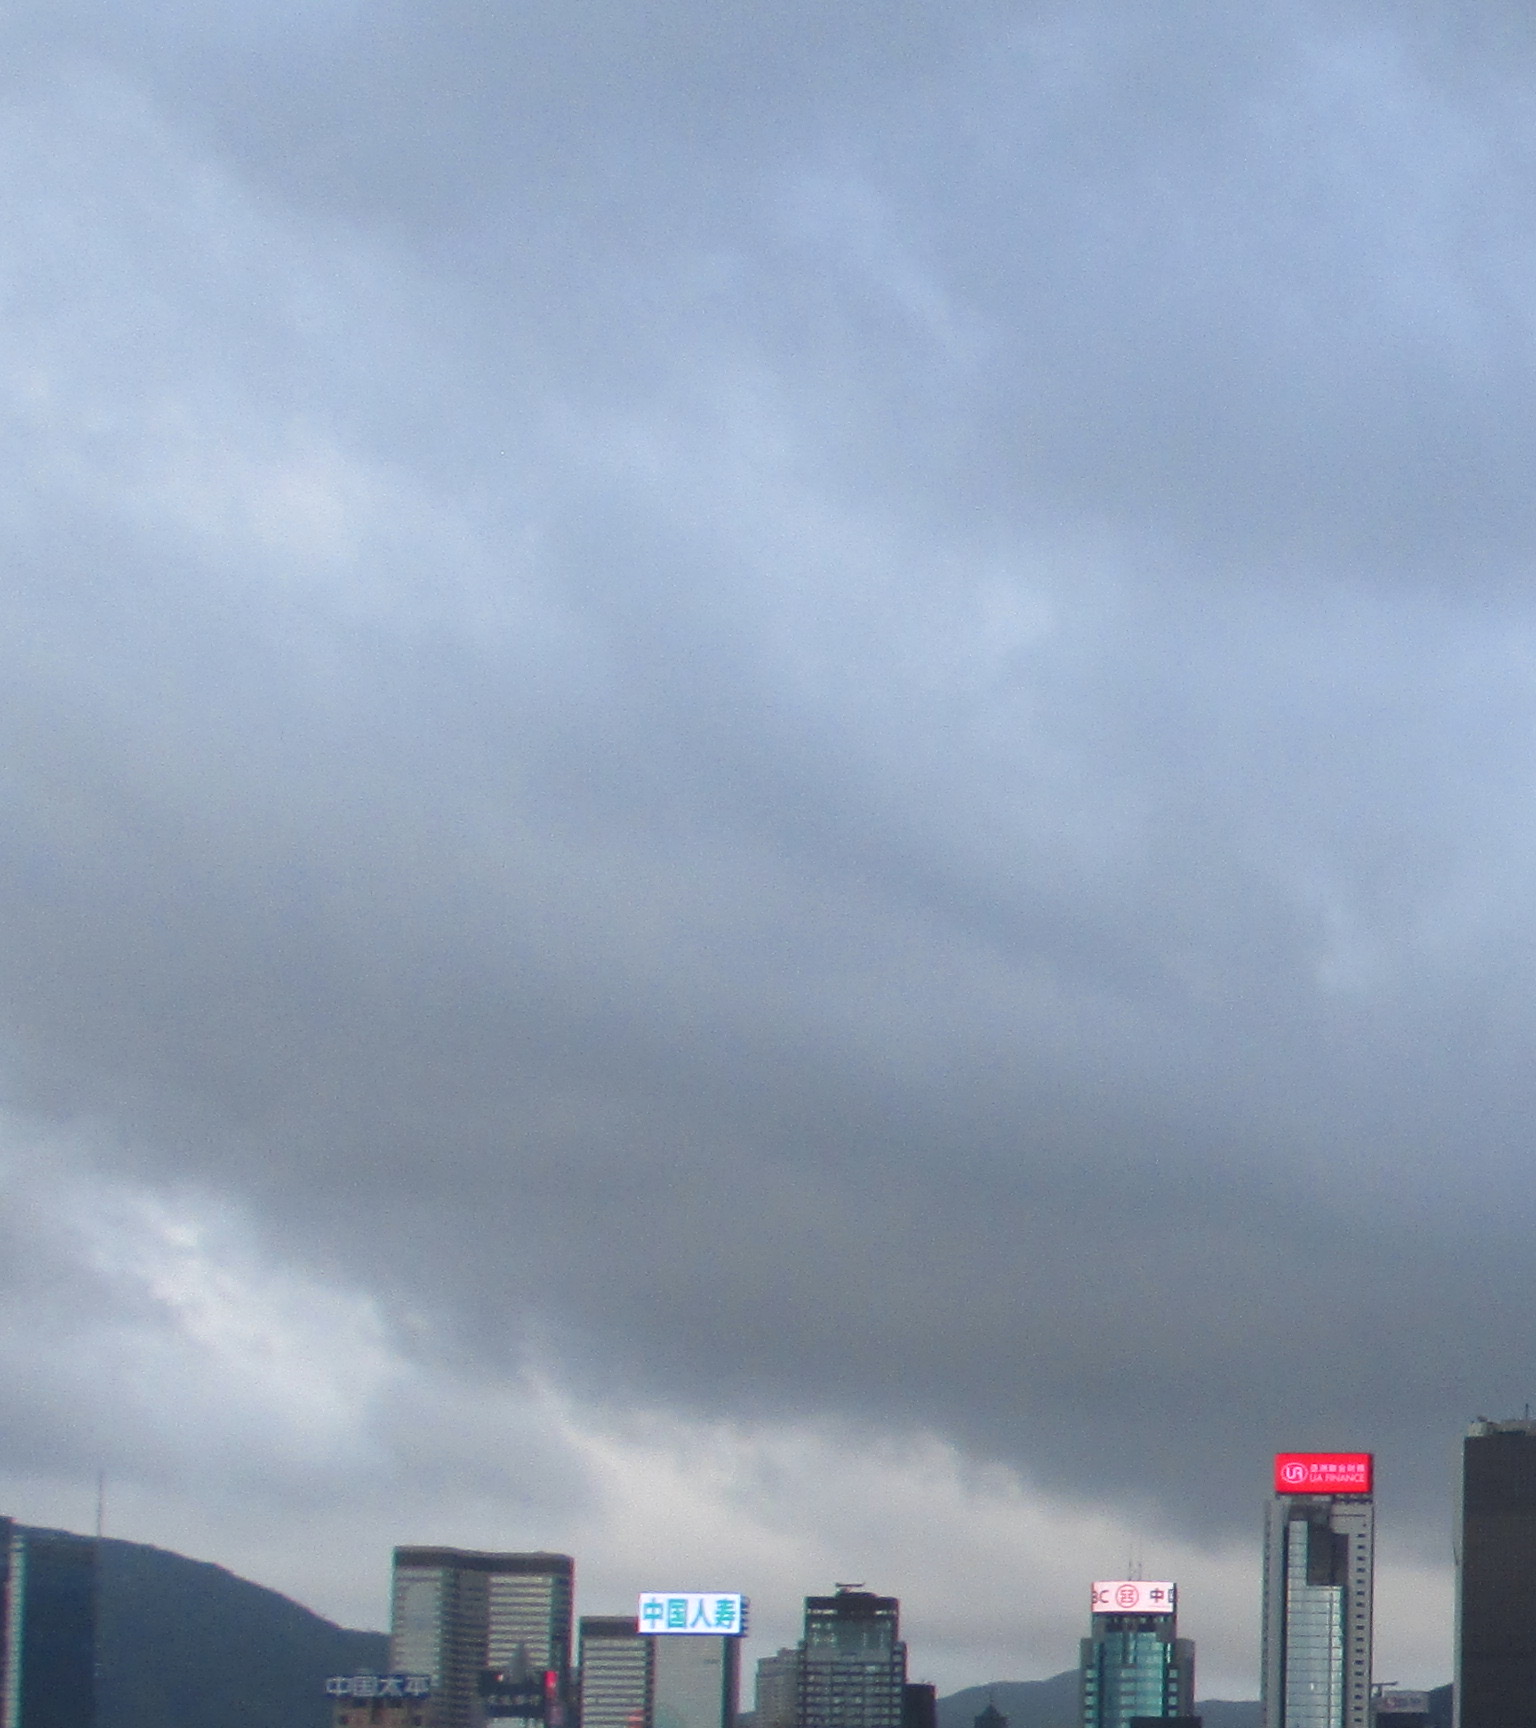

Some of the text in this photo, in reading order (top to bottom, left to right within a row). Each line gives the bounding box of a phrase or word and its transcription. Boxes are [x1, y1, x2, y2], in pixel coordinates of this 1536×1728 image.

[1325, 1473, 1365, 1482] FINANCE
[643, 1597, 736, 1629] 中国人寿
